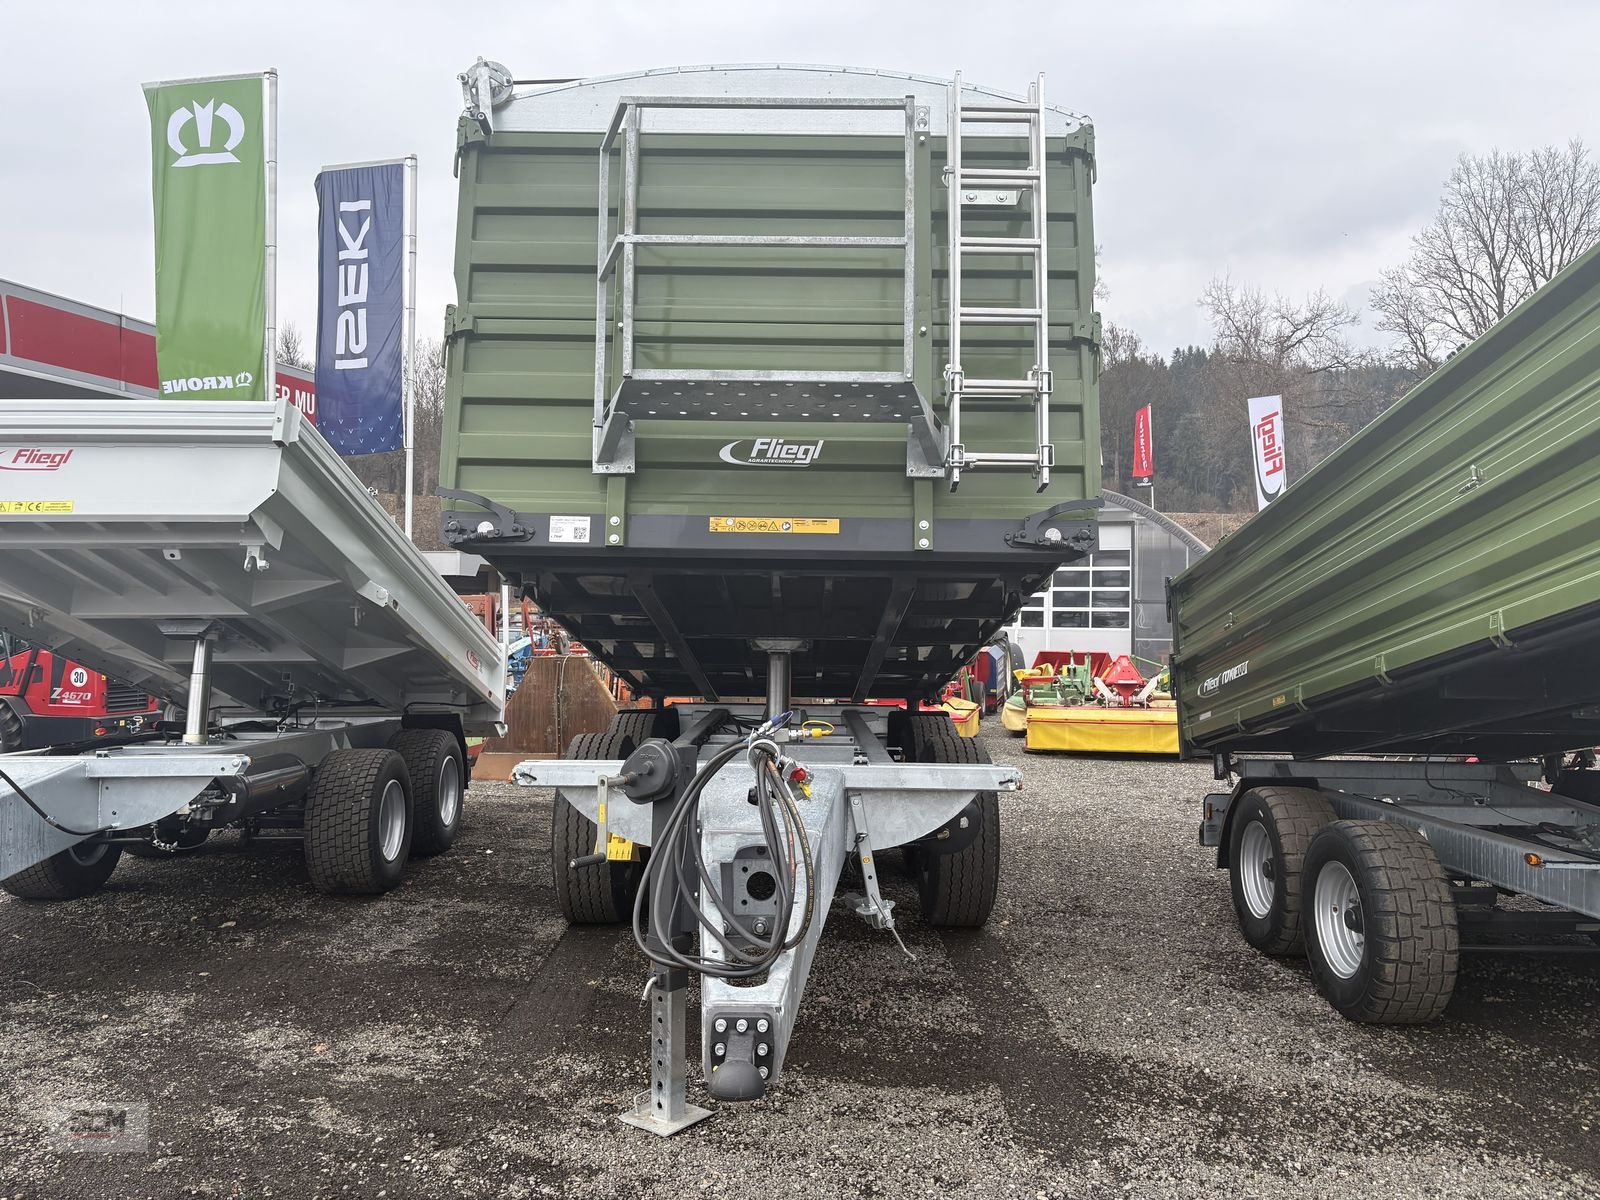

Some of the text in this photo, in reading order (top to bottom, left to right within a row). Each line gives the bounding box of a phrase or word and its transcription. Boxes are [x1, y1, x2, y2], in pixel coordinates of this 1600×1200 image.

[12, 449, 74, 467] Fliegl
[750, 438, 824, 464] Fliegl
[73, 671, 84, 684] 30
